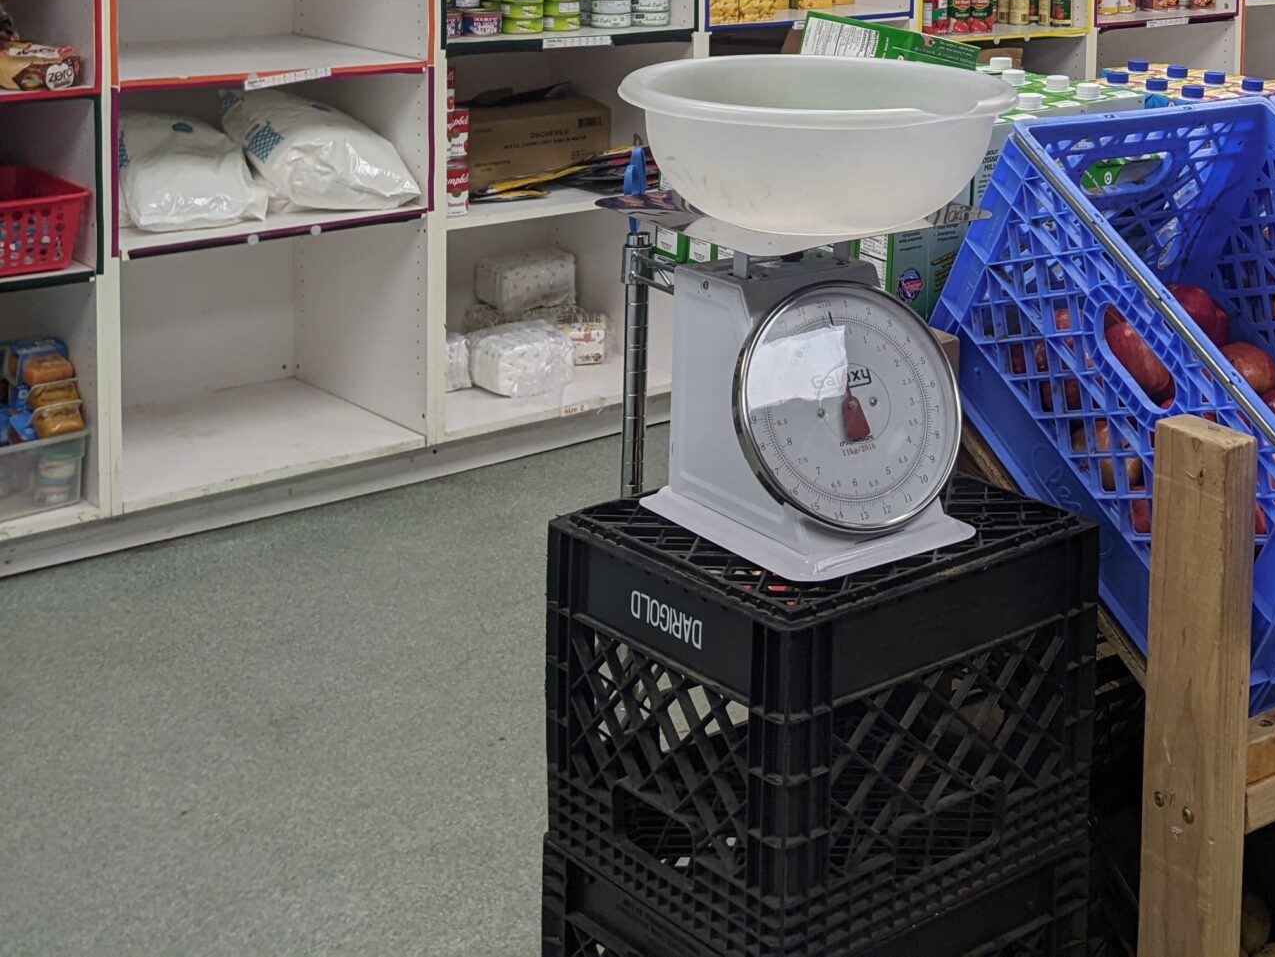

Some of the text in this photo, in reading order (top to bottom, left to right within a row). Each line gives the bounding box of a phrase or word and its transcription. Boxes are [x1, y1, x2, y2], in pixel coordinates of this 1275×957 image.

[48, 68, 73, 83] zero
[866, 306, 872, 316] 2
[894, 359, 900, 368] 2
[920, 356, 926, 366] 5
[930, 380, 936, 389] 6
[909, 397, 915, 406] 3
[564, 406, 578, 415] Size
[935, 431, 941, 440] 8
[787, 436, 793, 446] 8
[930, 454, 936, 464] 9
[815, 466, 821, 476] 7
[885, 466, 891, 476] 5
[852, 478, 858, 488] 6
[919, 474, 929, 484] 10
[903, 493, 913, 503] 11
[809, 502, 820, 512] 15
[882, 504, 893, 514] 12
[834, 510, 844, 520] 14
[860, 511, 870, 521] 13
[630, 590, 703, 651] DARIGOLD
